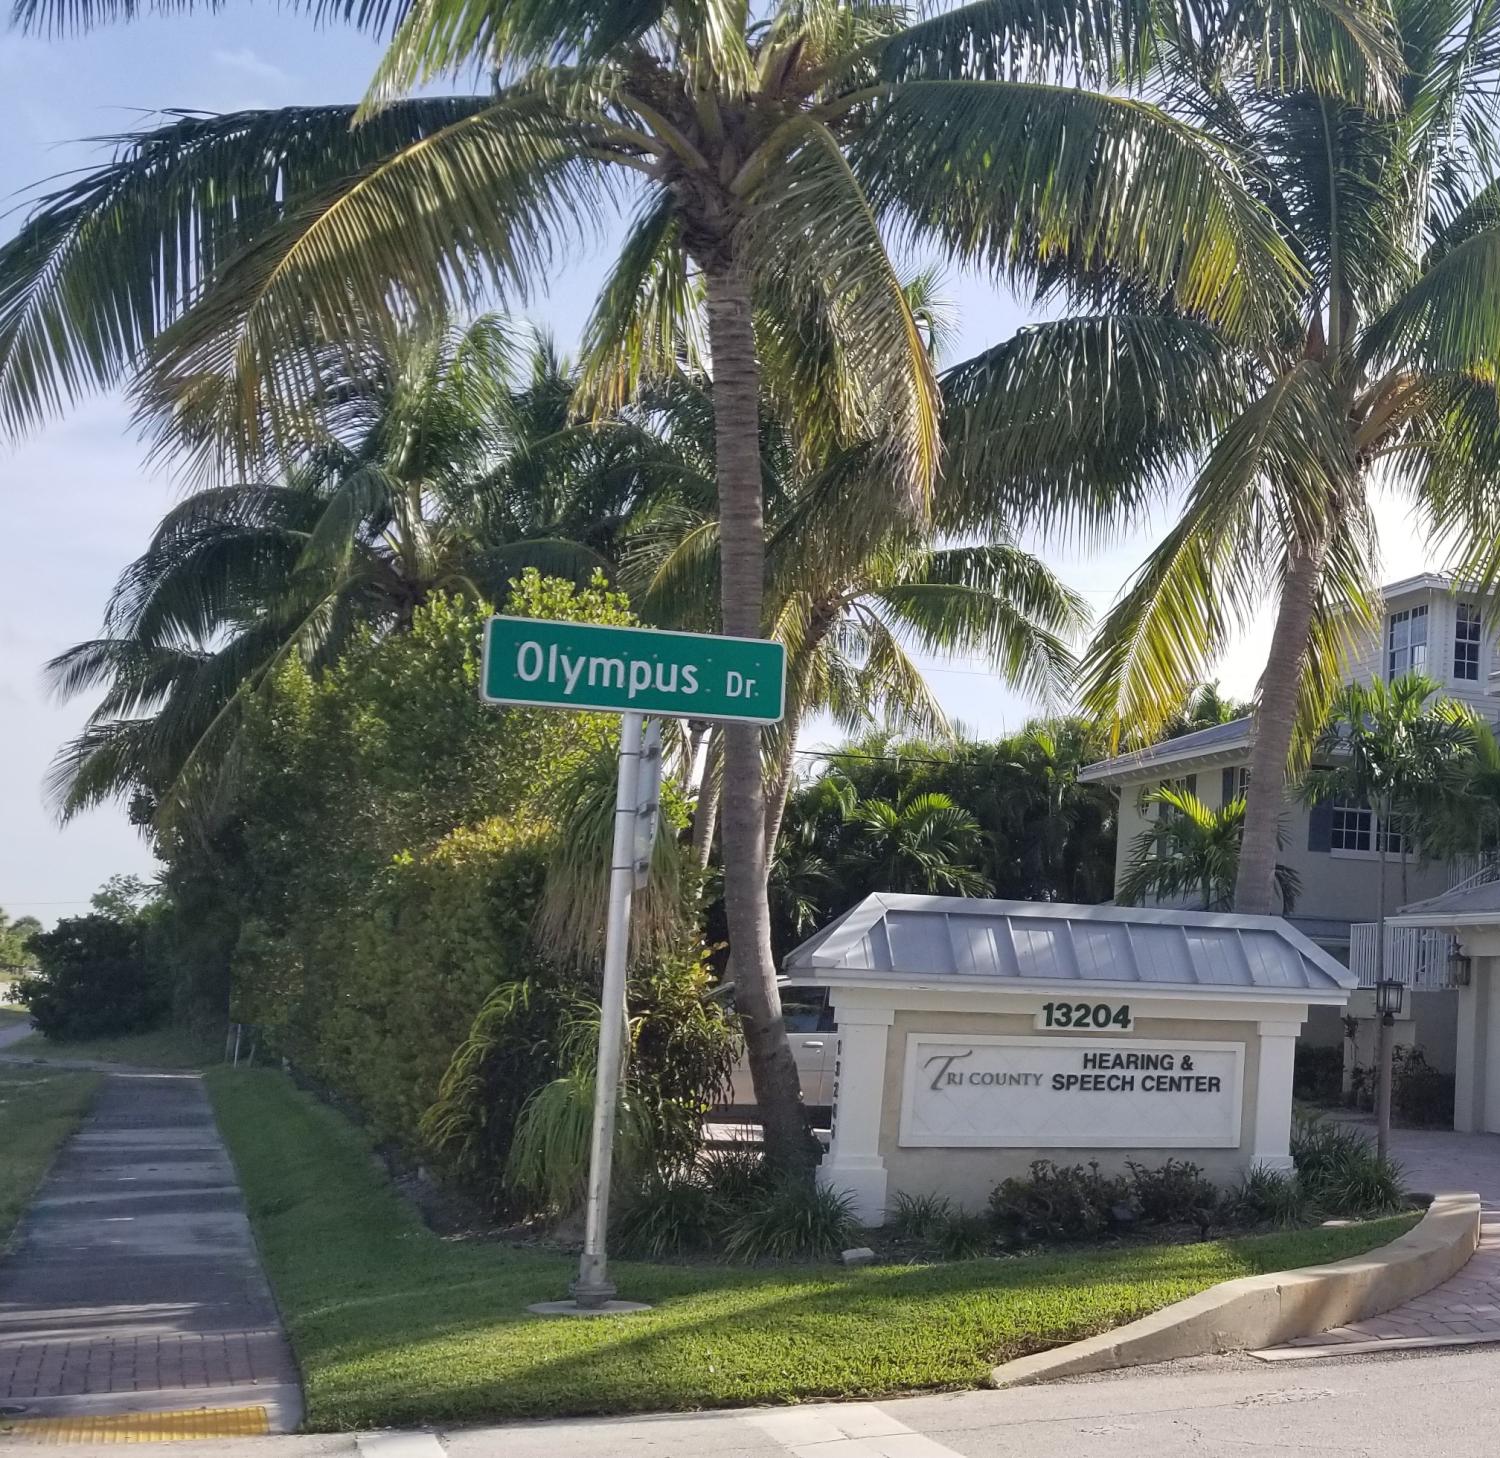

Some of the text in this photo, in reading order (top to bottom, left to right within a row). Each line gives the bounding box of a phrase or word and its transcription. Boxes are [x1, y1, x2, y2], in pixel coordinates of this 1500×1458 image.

[516, 641, 699, 699] Olympus
[1042, 1002, 1131, 1029] 13204
[923, 1049, 1044, 1091] TRI COUNTY
[1083, 1052, 1194, 1071] HEARING &
[1051, 1073, 1221, 1093] SPEECH CENTER
